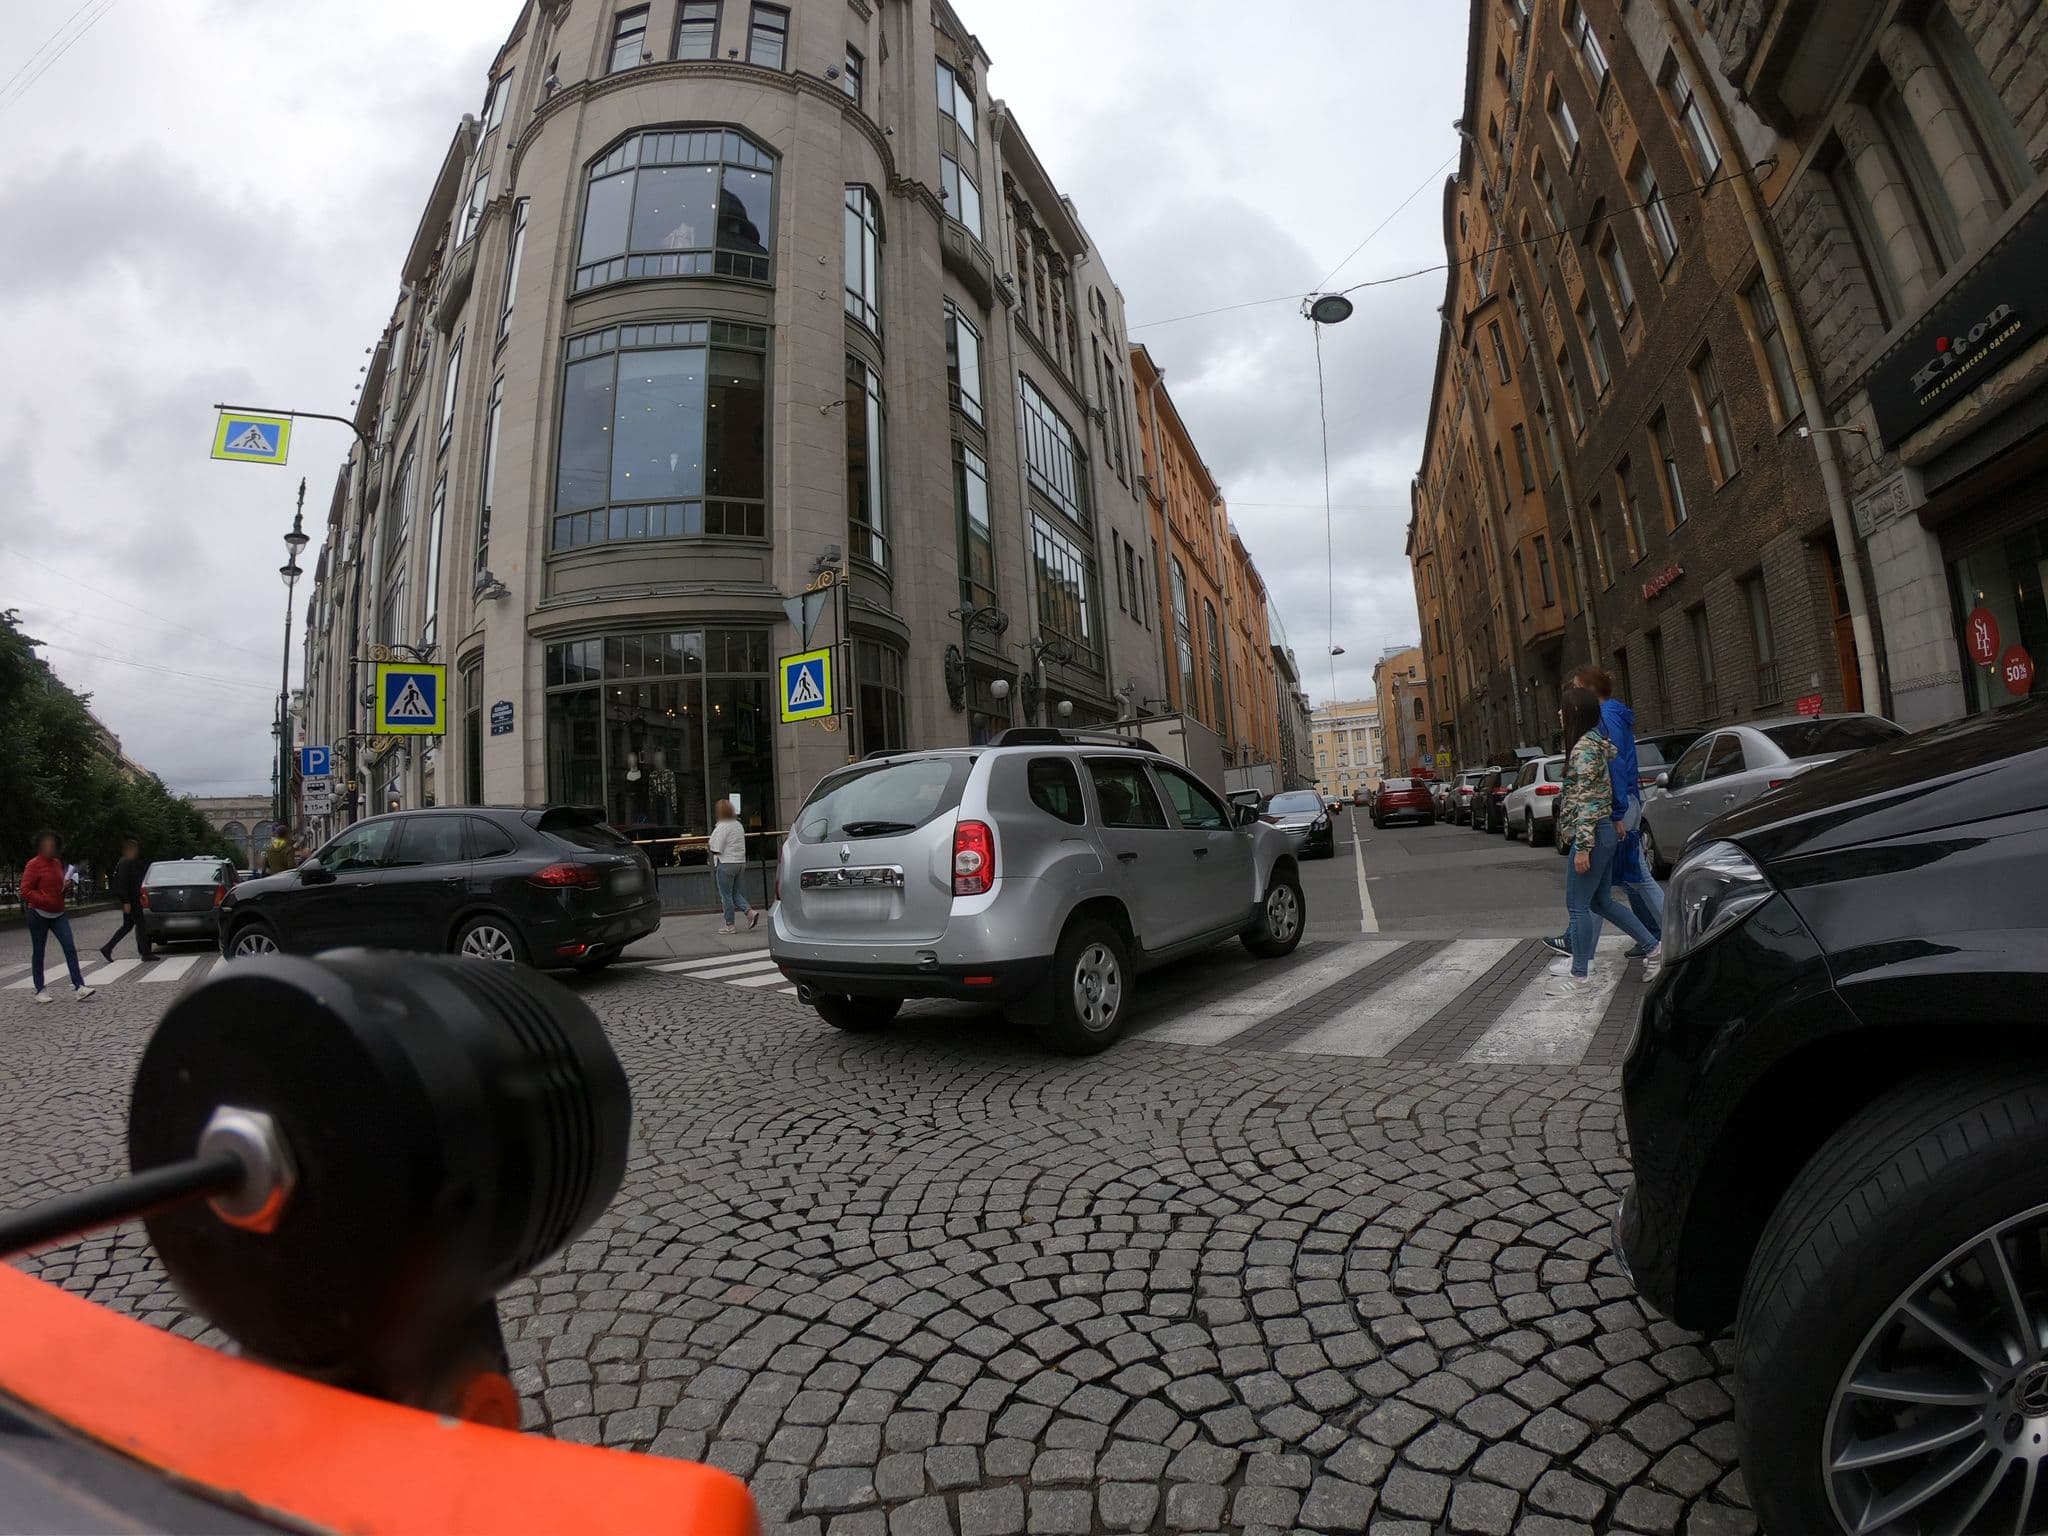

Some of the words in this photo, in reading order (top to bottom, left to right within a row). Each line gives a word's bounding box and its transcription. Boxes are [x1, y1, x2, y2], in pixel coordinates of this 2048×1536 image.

[1910, 304, 2015, 393] Kiton
[1989, 320, 2022, 351] ОДЕЖДЫ
[1974, 618, 1993, 657] SALE
[2006, 663, 2027, 682] 50%
[309, 750, 325, 773] P
